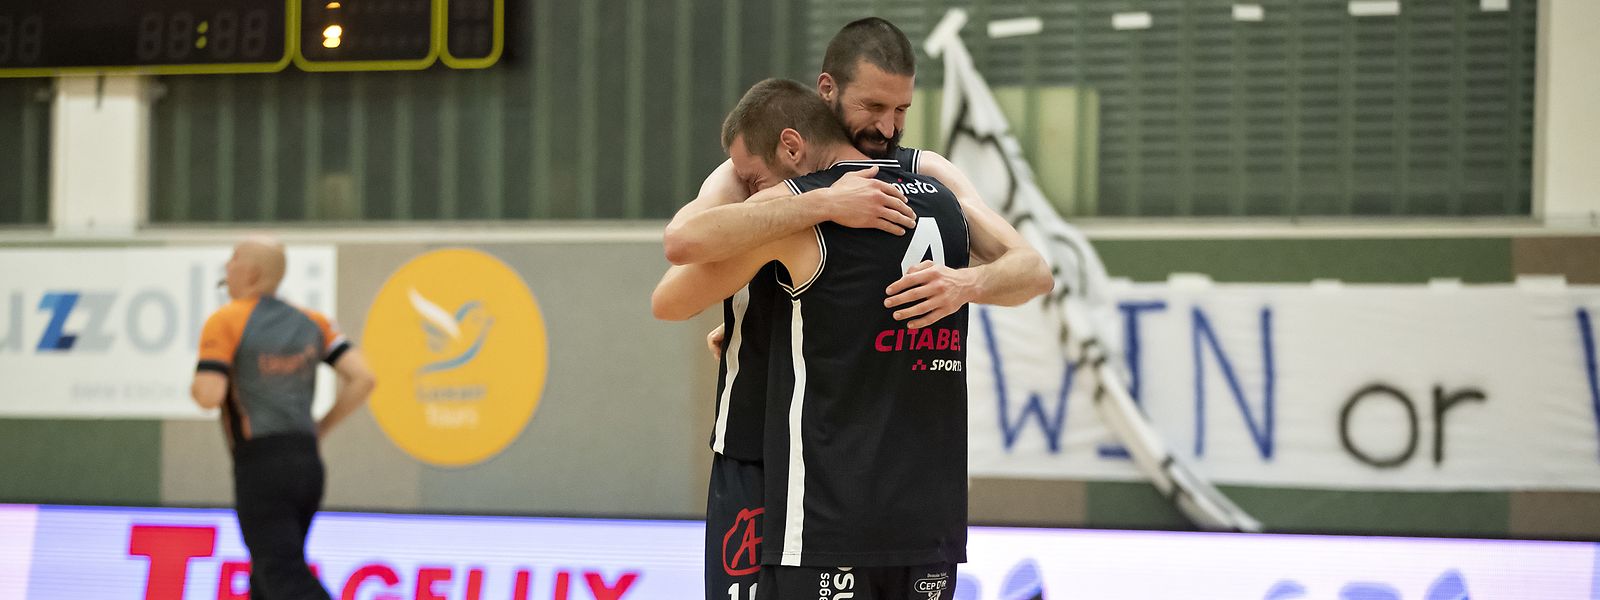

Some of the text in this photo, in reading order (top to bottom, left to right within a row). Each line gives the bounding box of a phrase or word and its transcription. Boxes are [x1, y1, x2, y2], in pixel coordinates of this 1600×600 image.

[874, 327, 961, 352] CITABE
[979, 301, 1275, 463] WIN
[1337, 378, 1487, 469] or
[128, 525, 639, 600] TGELUX
